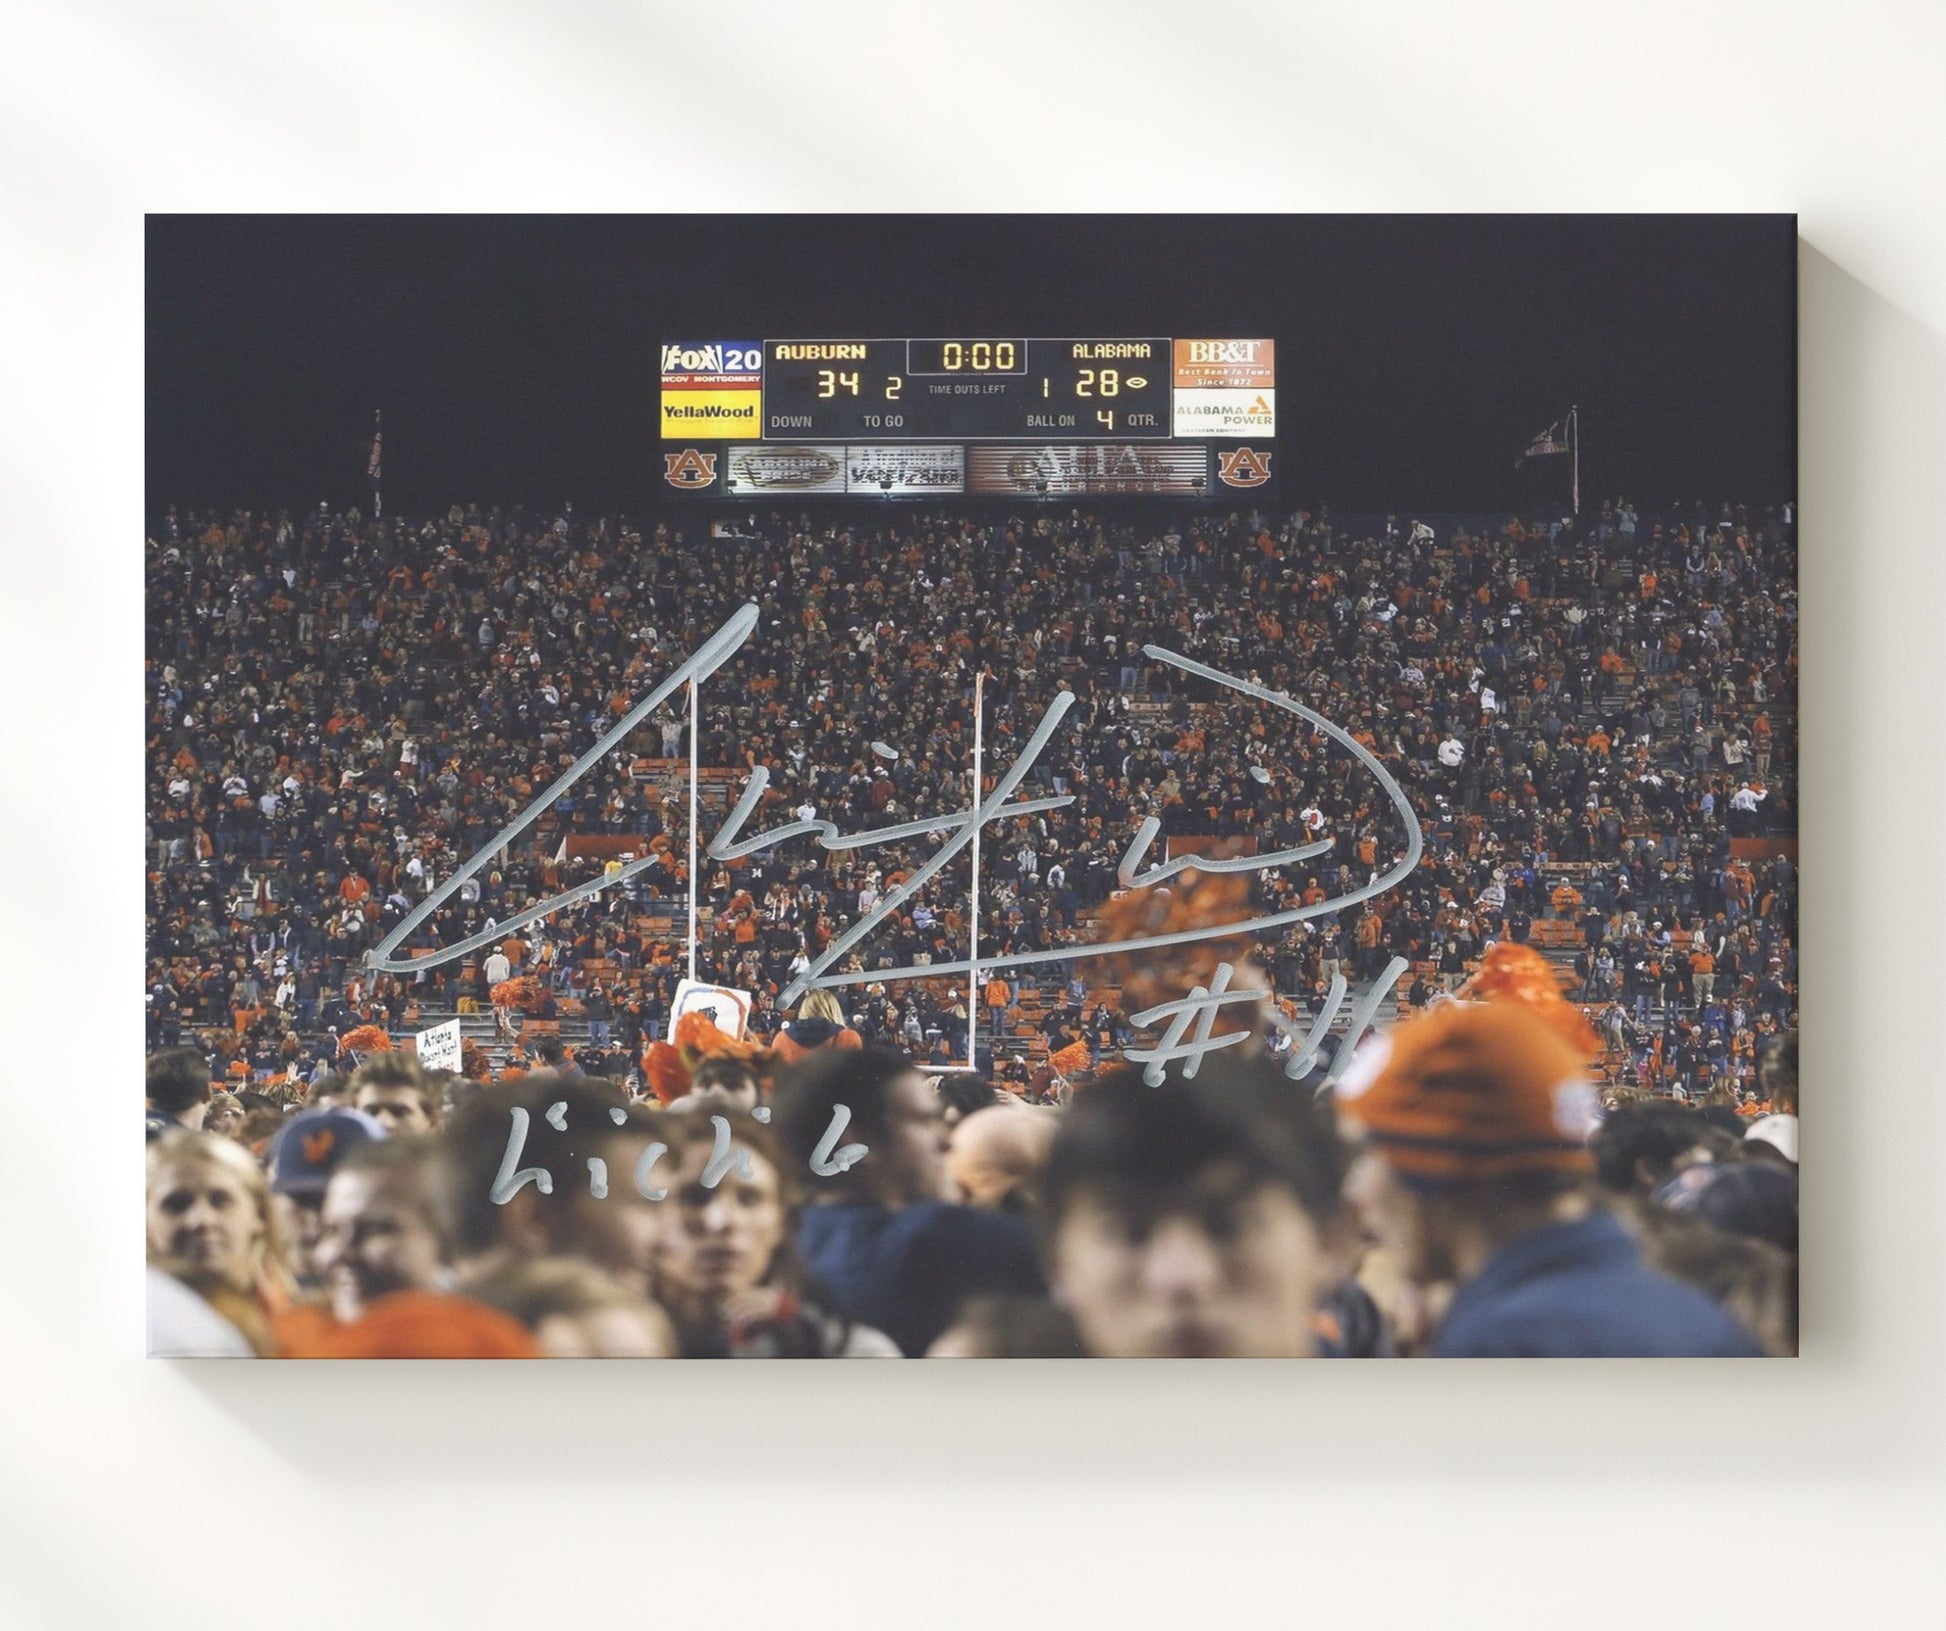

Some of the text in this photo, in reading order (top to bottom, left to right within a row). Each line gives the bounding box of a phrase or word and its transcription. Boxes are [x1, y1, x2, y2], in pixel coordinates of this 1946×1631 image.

[776, 345, 866, 359] AUBURN
[943, 343, 1014, 370] 0:00
[1072, 344, 1151, 358] ALABAMA
[1189, 342, 1261, 362] BB&T
[662, 345, 762, 373] FOX 20
[694, 375, 761, 383] MONTGOMERY
[818, 370, 858, 397] 34
[1076, 369, 1118, 396] 28
[886, 377, 902, 399] 2
[929, 385, 1006, 394] TIME OUTS LEFT
[1043, 378, 1049, 398] 1
[664, 405, 754, 418] YellaWood
[1177, 406, 1243, 415] ALABAMA
[771, 416, 812, 427] DOWN
[864, 415, 903, 427] TO GO
[1027, 415, 1075, 426] BALL ON
[1097, 410, 1113, 430] 4
[1128, 414, 1159, 426] QTR.
[1224, 416, 1272, 424] POWER
